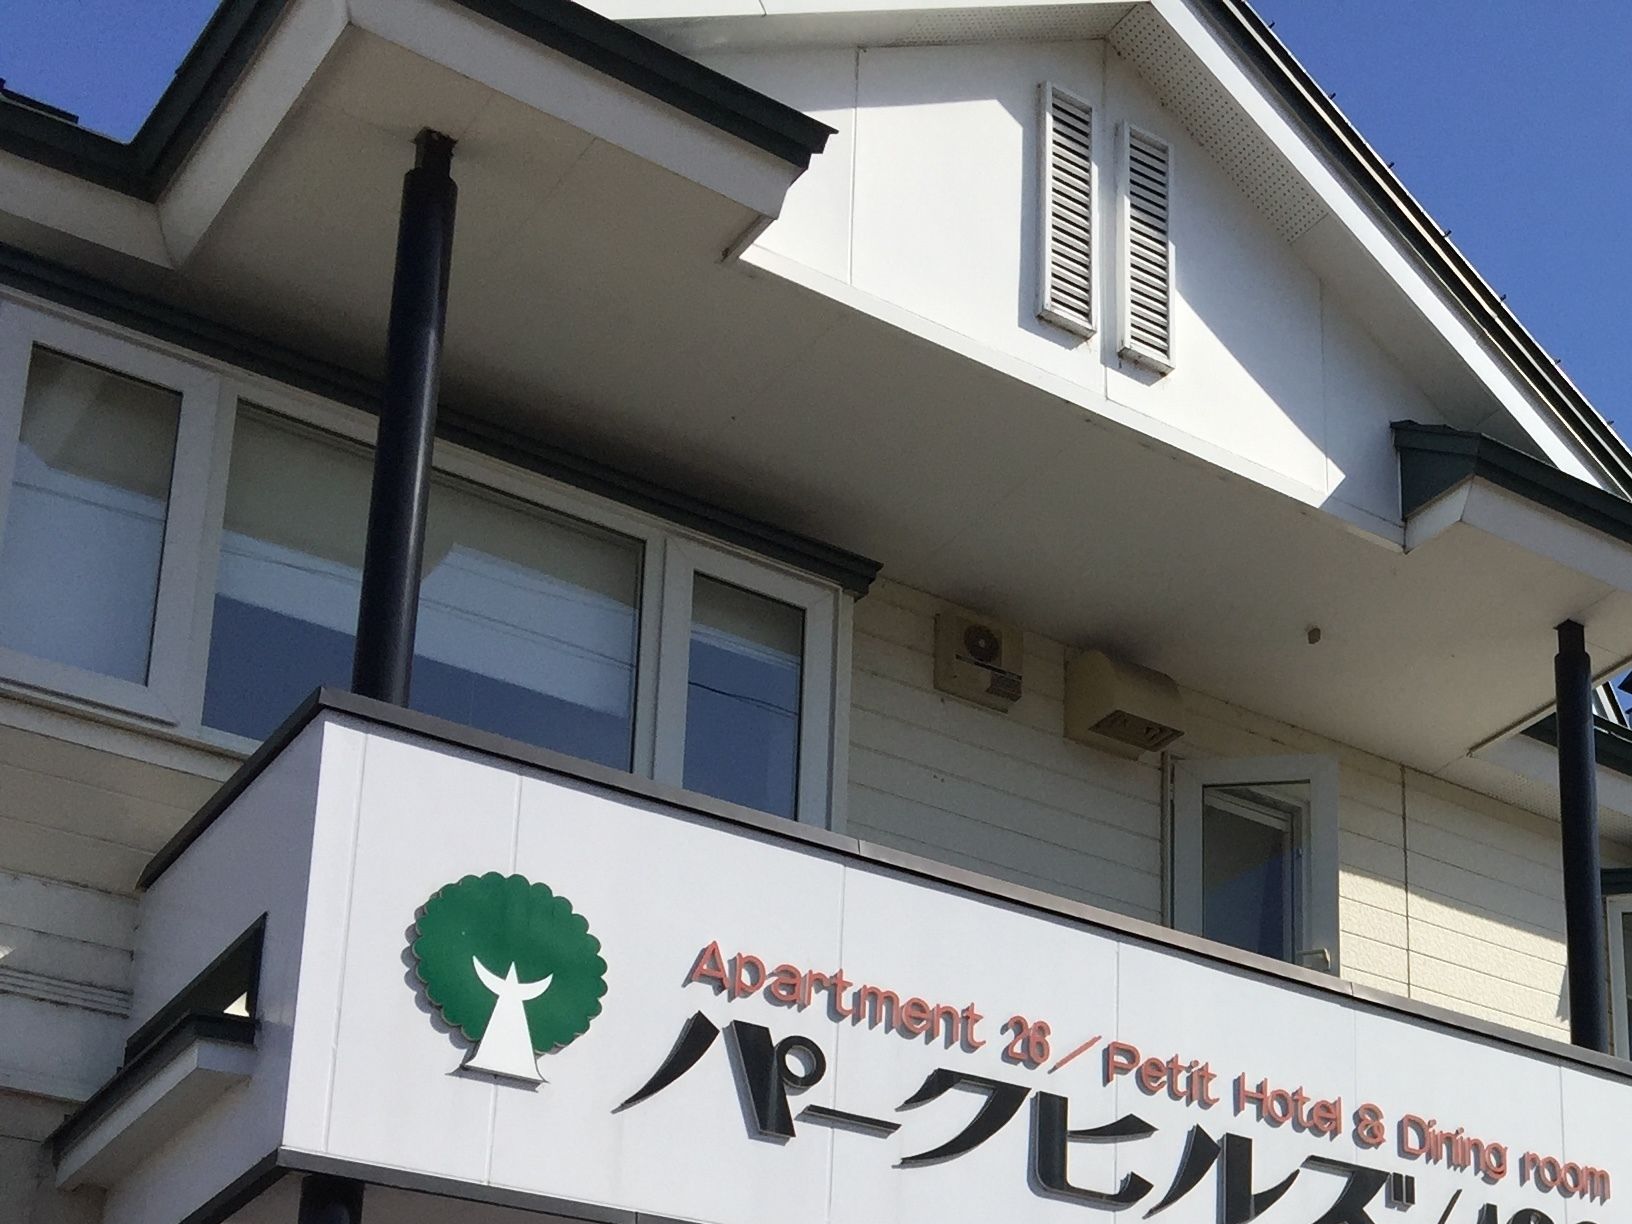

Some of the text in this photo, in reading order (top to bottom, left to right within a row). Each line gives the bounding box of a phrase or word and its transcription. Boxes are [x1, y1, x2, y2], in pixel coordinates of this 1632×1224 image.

[686, 940, 988, 1050] Apartment
[1235, 1071, 1343, 1138] Hotel
[1354, 1103, 1387, 1148] &
[1399, 1113, 1509, 1182] Dining
[1520, 1150, 1612, 1204] room
